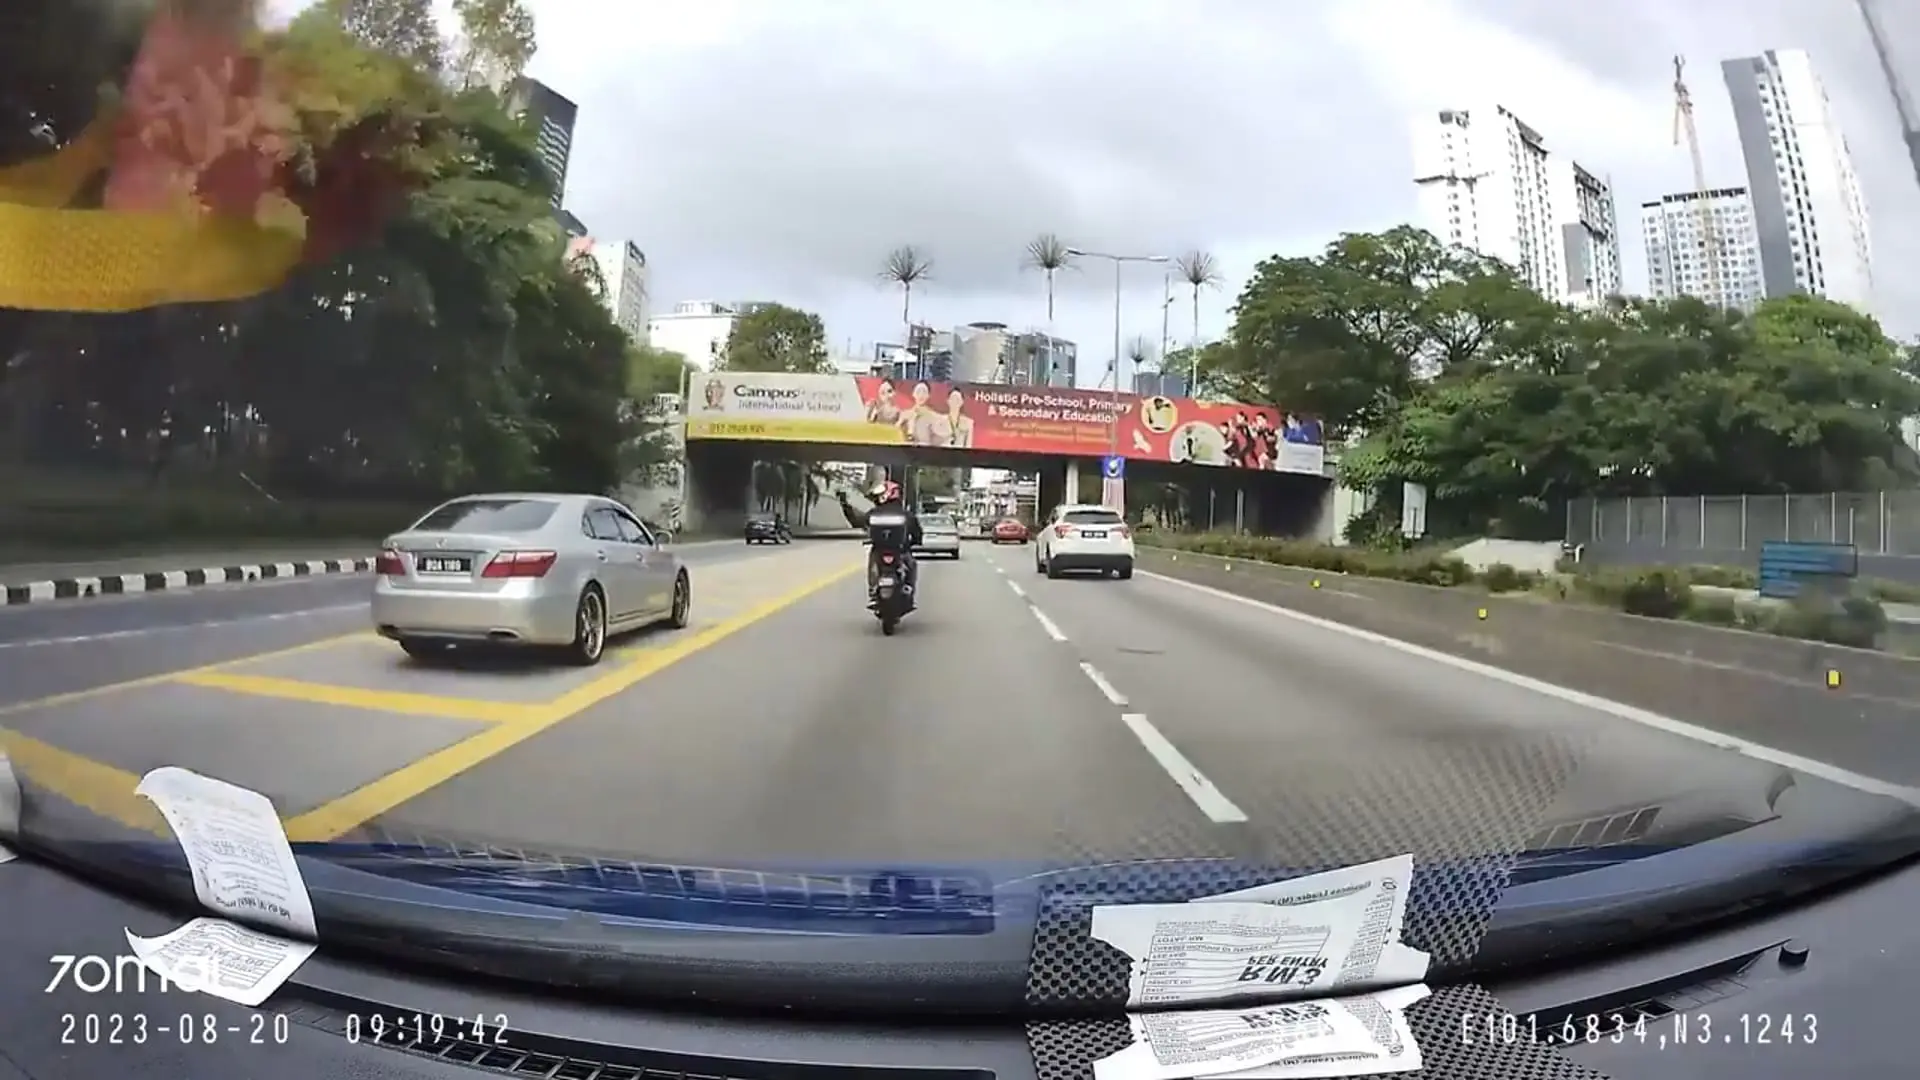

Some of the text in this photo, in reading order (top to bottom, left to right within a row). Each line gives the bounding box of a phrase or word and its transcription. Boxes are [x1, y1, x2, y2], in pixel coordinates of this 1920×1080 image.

[733, 384, 799, 399] Campus
[738, 399, 842, 413] International School
[975, 390, 1018, 404] Holistic
[1089, 398, 1133, 415] Primary
[1000, 405, 1060, 421] Secondary
[1063, 409, 1119, 424] Education
